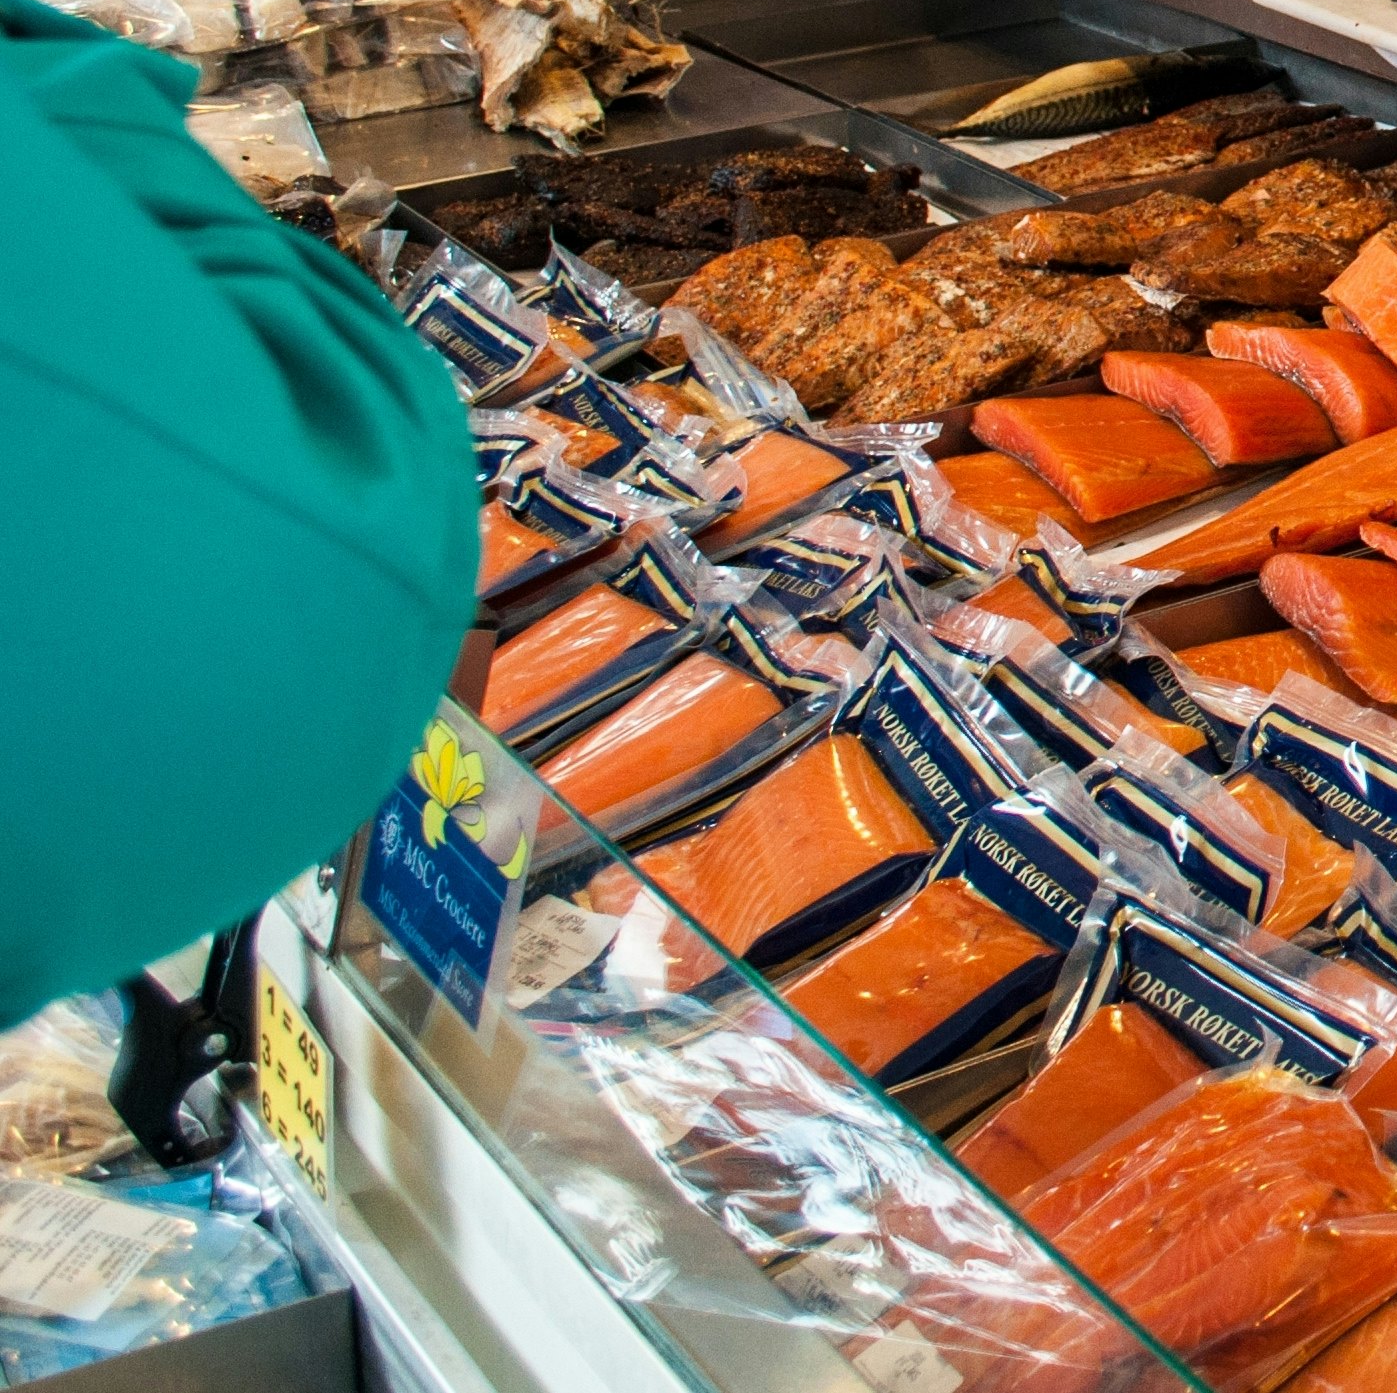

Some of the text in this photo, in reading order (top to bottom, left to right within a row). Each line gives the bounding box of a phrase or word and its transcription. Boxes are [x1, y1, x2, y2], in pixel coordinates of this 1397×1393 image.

[872, 702, 922, 760] NORSK
[909, 751, 961, 808] RØKET
[1317, 783, 1382, 828] RØKET
[404, 835, 487, 949] MSC Crociere
[968, 823, 1078, 915] NORSK RØKET
[267, 984, 276, 1016] 1
[298, 1029, 320, 1077] 49
[1118, 960, 1320, 1086] NORSK RØKET AKS
[261, 1032, 272, 1068] 3
[293, 1080, 326, 1144] 140
[261, 1089, 272, 1125] 6
[294, 1133, 327, 1203] 245
